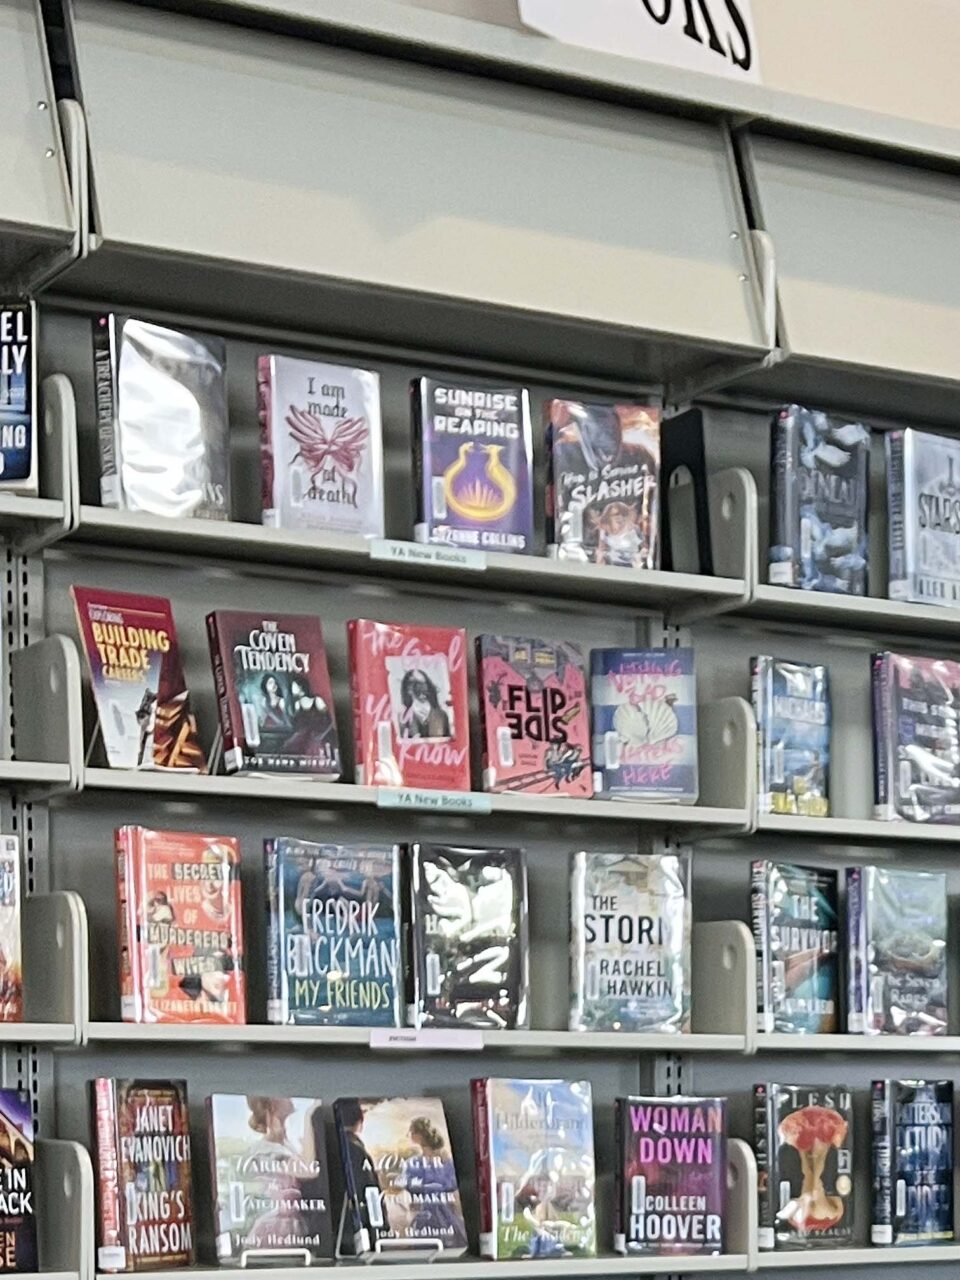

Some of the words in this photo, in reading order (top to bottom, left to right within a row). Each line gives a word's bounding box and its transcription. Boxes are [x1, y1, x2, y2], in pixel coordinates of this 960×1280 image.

[307, 377, 316, 395] I
[320, 383, 346, 400] am
[434, 387, 518, 411] SUNRISE
[433, 415, 520, 439] REAPING
[390, 546, 406, 557] YA
[408, 549, 432, 560] New
[91, 621, 170, 653] BUILDING
[249, 629, 297, 652] COVEN
[96, 643, 152, 670] TRADE
[234, 644, 310, 674] TENDENCY
[507, 684, 567, 715] FLIP
[398, 728, 469, 770] Know
[397, 793, 412, 803] YA
[415, 794, 439, 805] New
[441, 797, 474, 809] Books
[148, 863, 169, 880] THE
[173, 863, 226, 881] SECRET
[166, 885, 202, 904] LIVES
[592, 894, 619, 911] THE
[183, 908, 199, 925] OF
[302, 898, 380, 937] FREDRIK
[791, 894, 820, 922] THE
[286, 934, 401, 979] BACKMAN
[600, 958, 666, 978] RACHEL
[295, 980, 320, 1009] MY
[322, 981, 391, 1011] FRIENDS
[606, 979, 674, 998] HAWKIN
[135, 1105, 174, 1132] JANET
[630, 1105, 722, 1134] WOMAN
[121, 1136, 192, 1163] EVANOVICH
[639, 1137, 713, 1165] DOWN
[362, 1158, 372, 1171] A
[7, 1168, 27, 1190] IN
[134, 1190, 185, 1220] KING'S
[645, 1194, 706, 1213] COLLEEN
[128, 1223, 192, 1255] RANSOM
[267, 1233, 320, 1246] Hedlund
[375, 1228, 401, 1240] Jody
[404, 1224, 456, 1238] Hedlund
[629, 1214, 722, 1241] HOOVER
